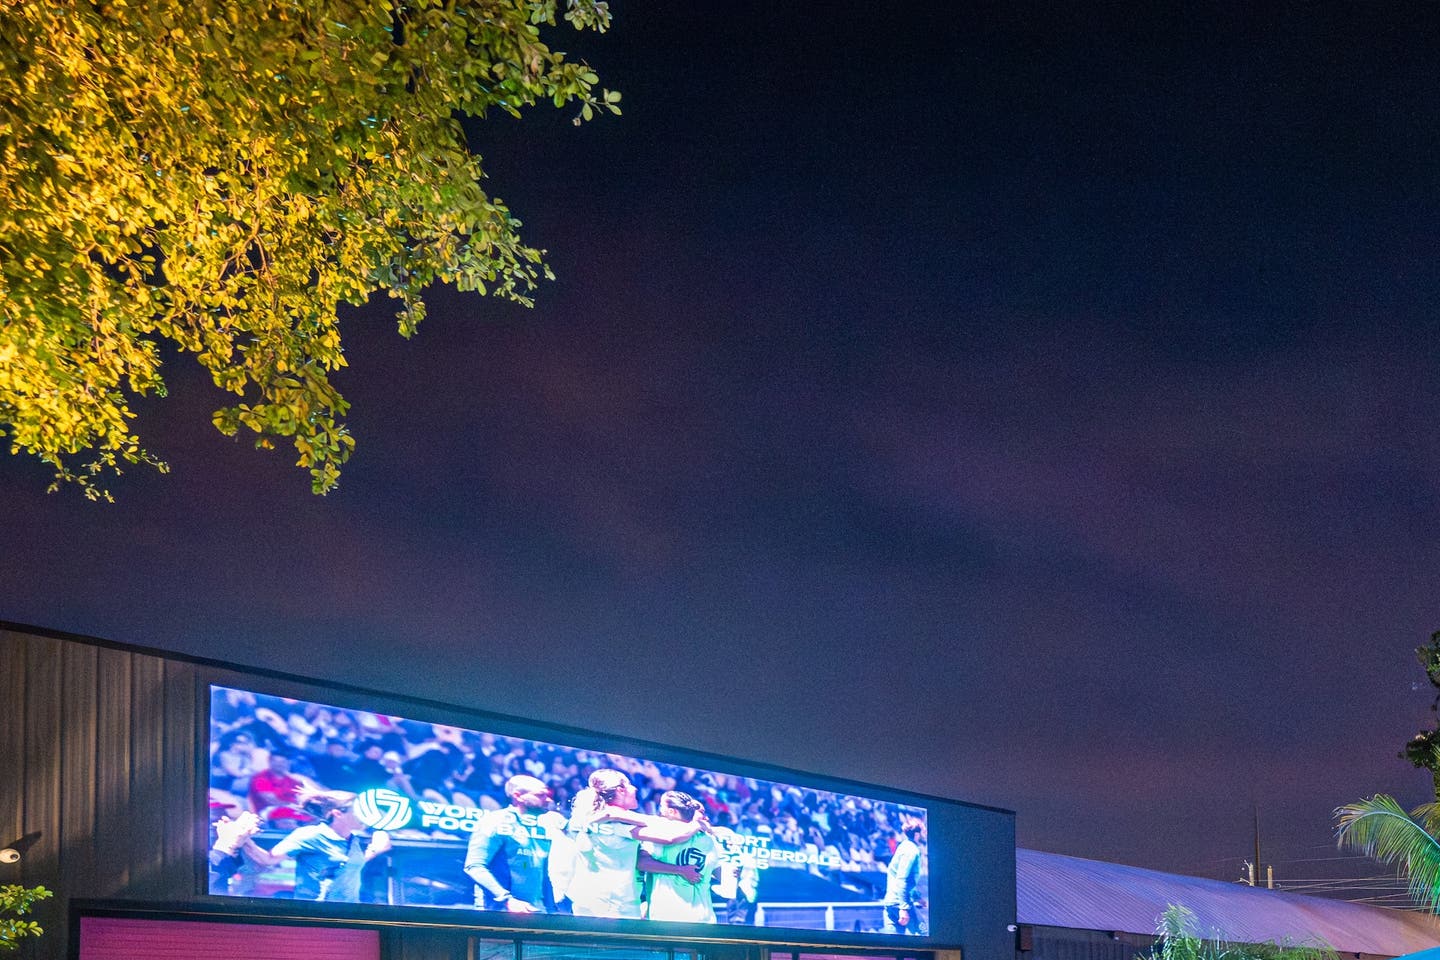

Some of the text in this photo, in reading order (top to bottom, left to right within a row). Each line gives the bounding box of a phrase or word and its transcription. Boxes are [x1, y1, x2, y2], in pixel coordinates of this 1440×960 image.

[418, 801, 614, 835] WORD SNS
[422, 814, 557, 840] FOOBAL
[720, 834, 771, 848] FORT
